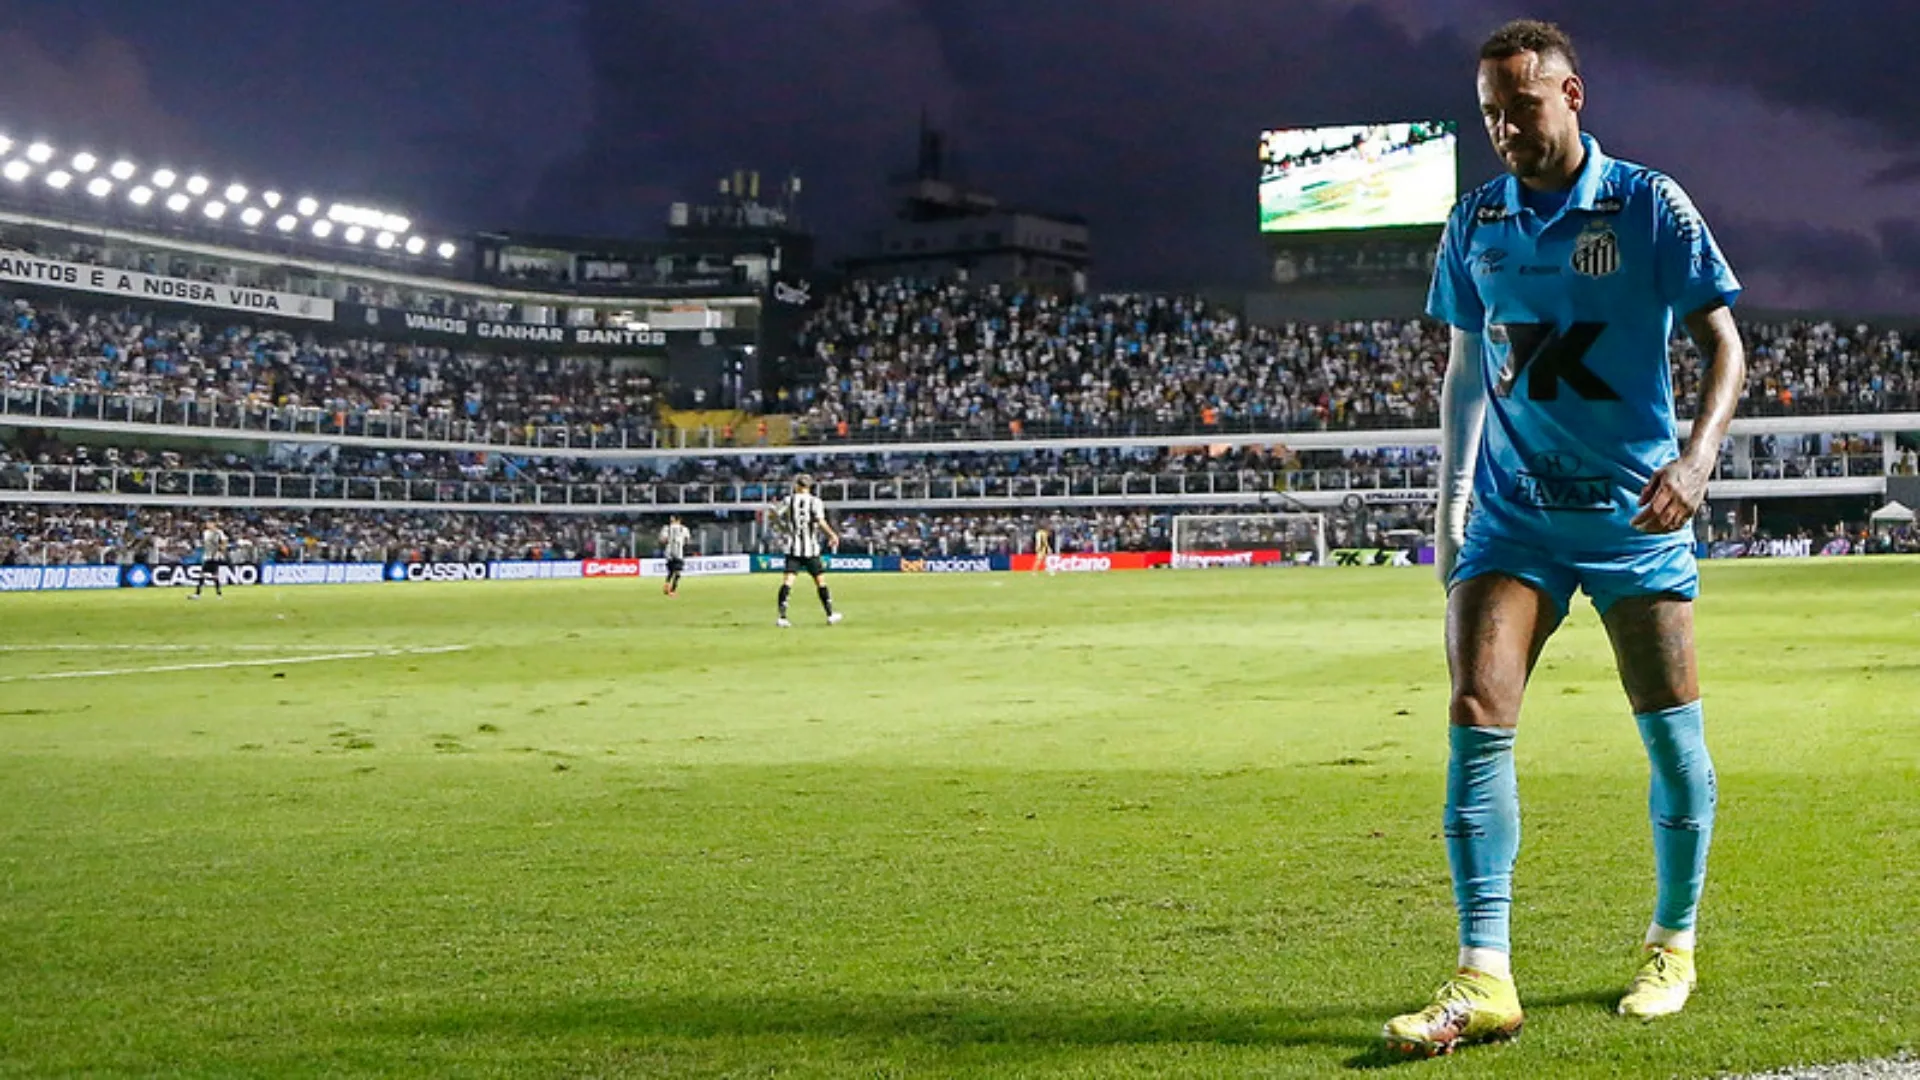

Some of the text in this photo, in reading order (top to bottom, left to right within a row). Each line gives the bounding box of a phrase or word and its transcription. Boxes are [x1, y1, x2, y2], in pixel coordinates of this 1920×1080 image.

[117, 274, 132, 290] A
[143, 279, 216, 301] NOSSA
[230, 289, 279, 309] VIDA
[405, 312, 666, 345] VAMOS GANHAR SANTOS
[408, 562, 486, 581] CASSINO
[901, 556, 990, 571] betnacional
